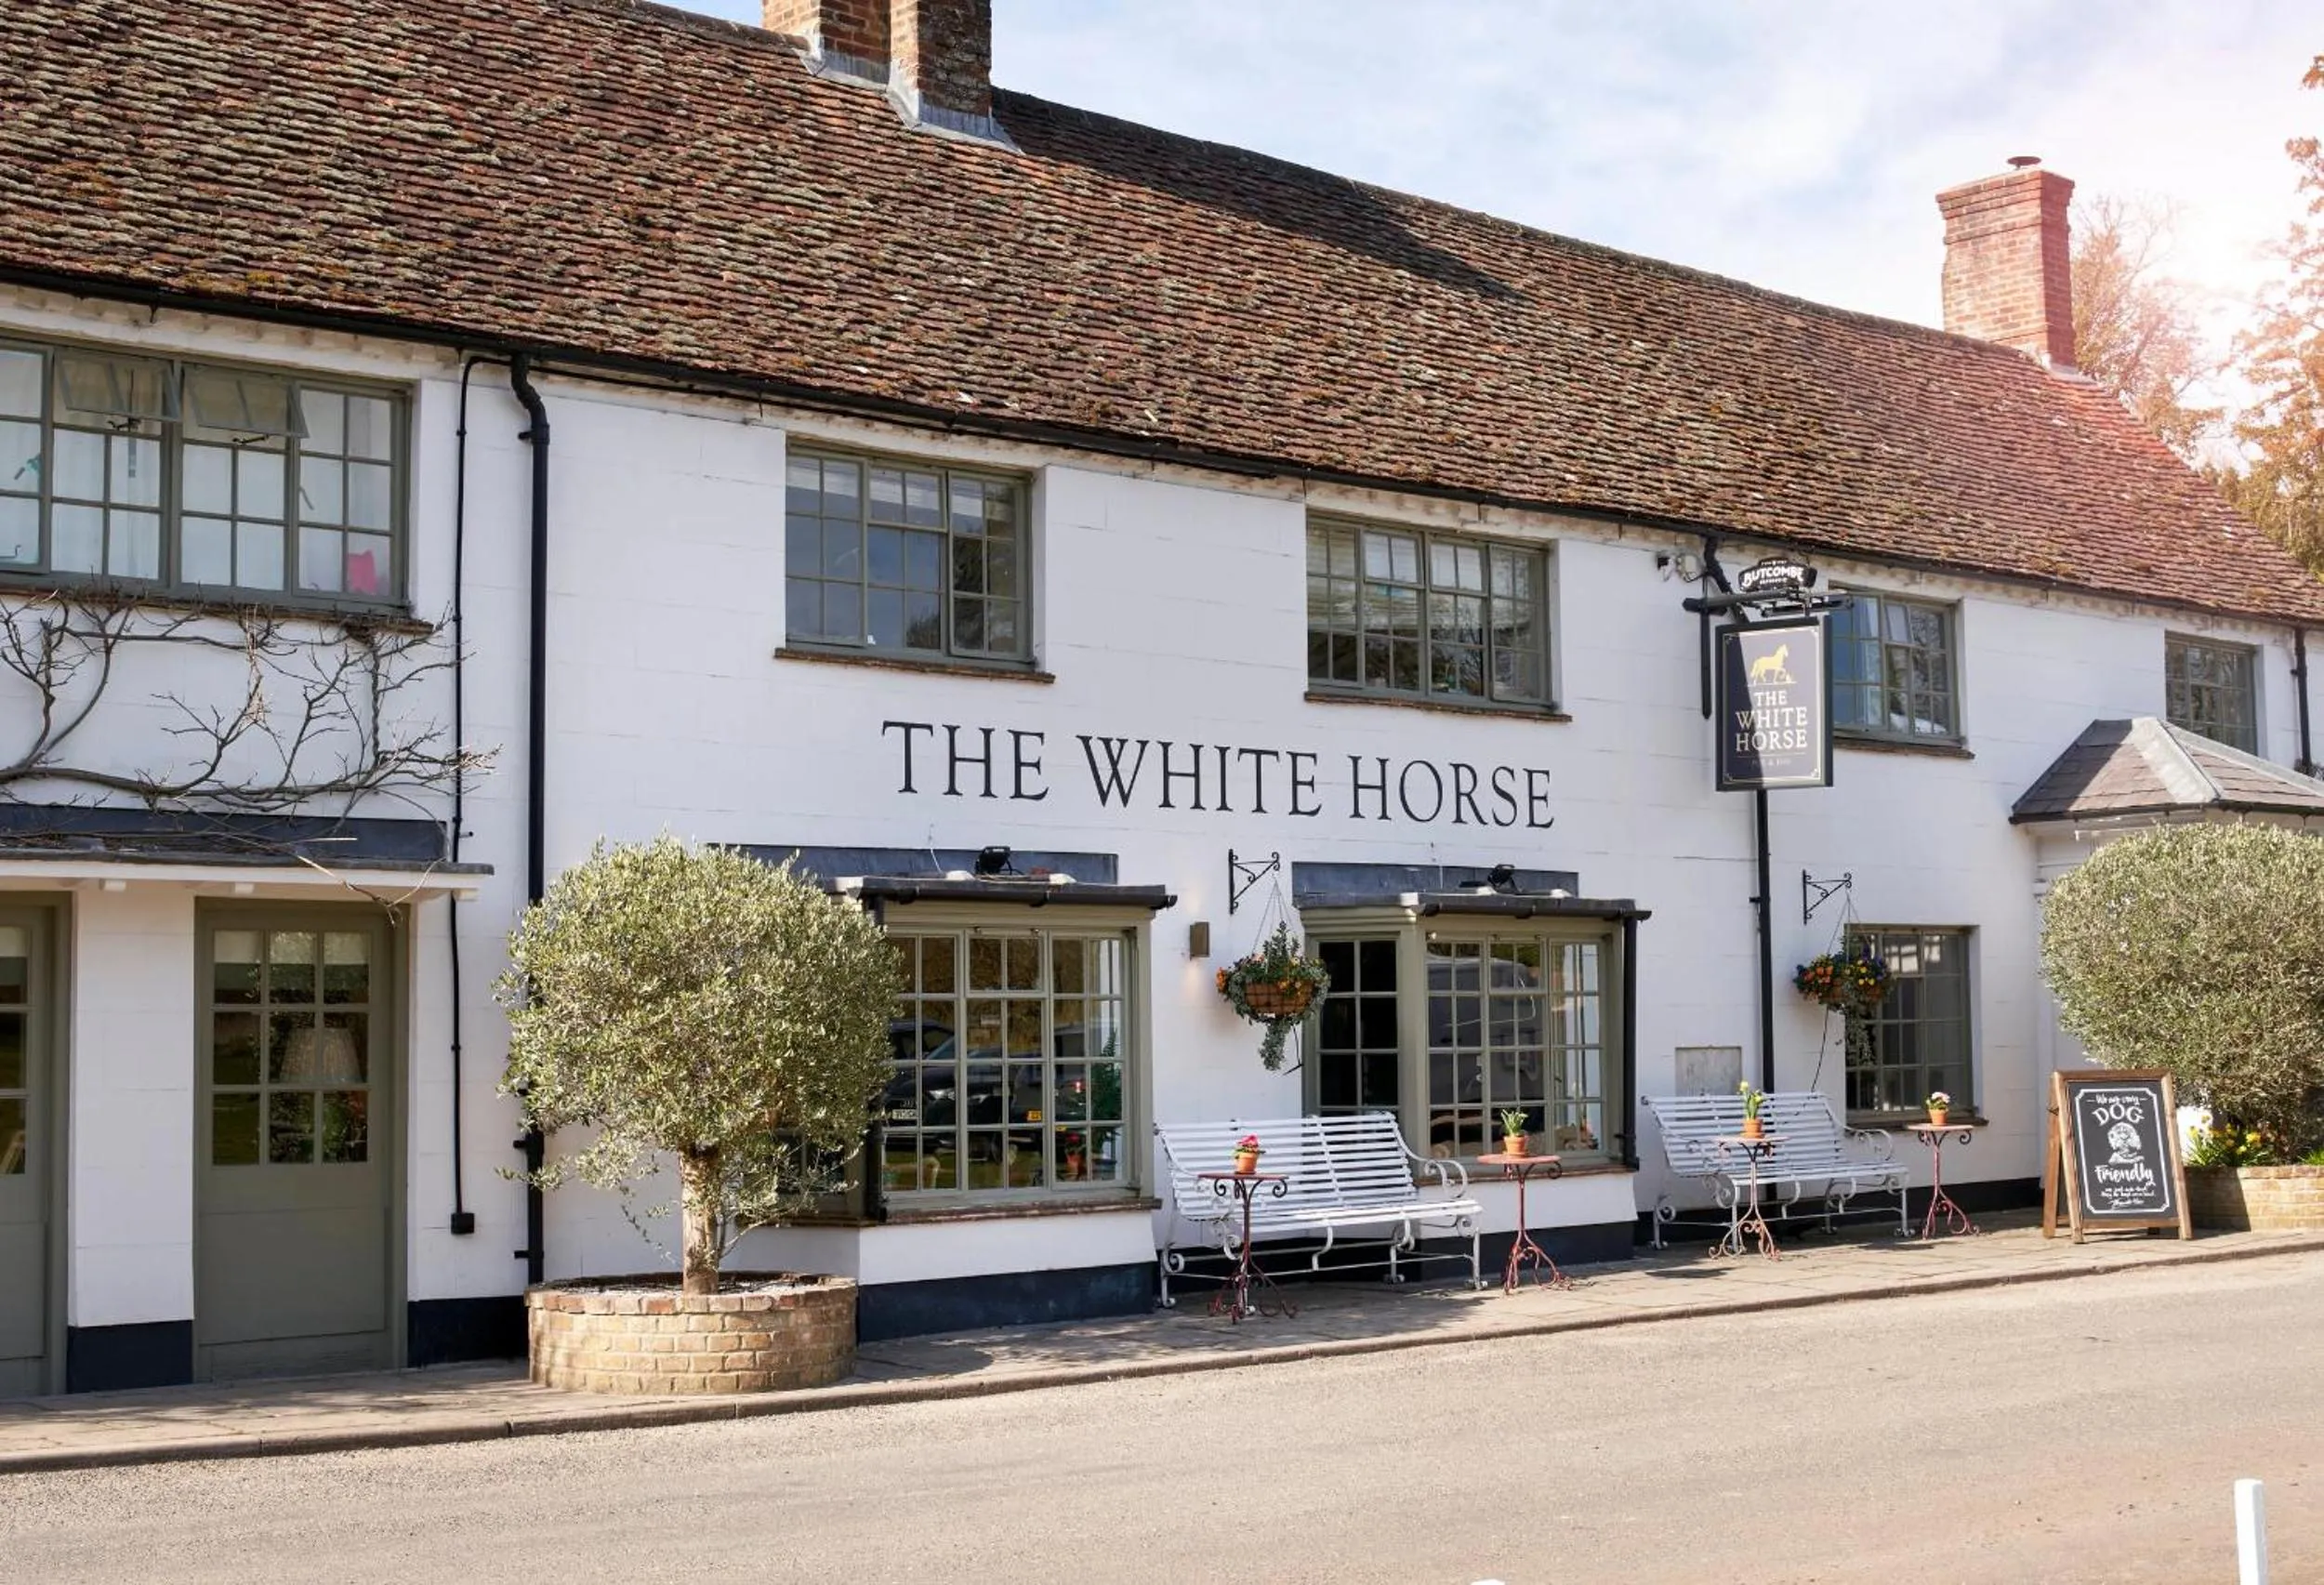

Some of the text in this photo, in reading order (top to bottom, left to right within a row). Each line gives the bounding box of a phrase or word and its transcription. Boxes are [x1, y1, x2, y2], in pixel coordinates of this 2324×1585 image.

[1741, 566, 1803, 587] BUTCOMBE
[1753, 690, 1787, 707] THE
[1735, 706, 1808, 730] WHITE
[1736, 729, 1808, 752] HORSE
[882, 720, 1555, 829] THE WHITE HORSE
[2092, 1103, 2145, 1126] DOG
[2094, 1162, 2156, 1186] Friendly
